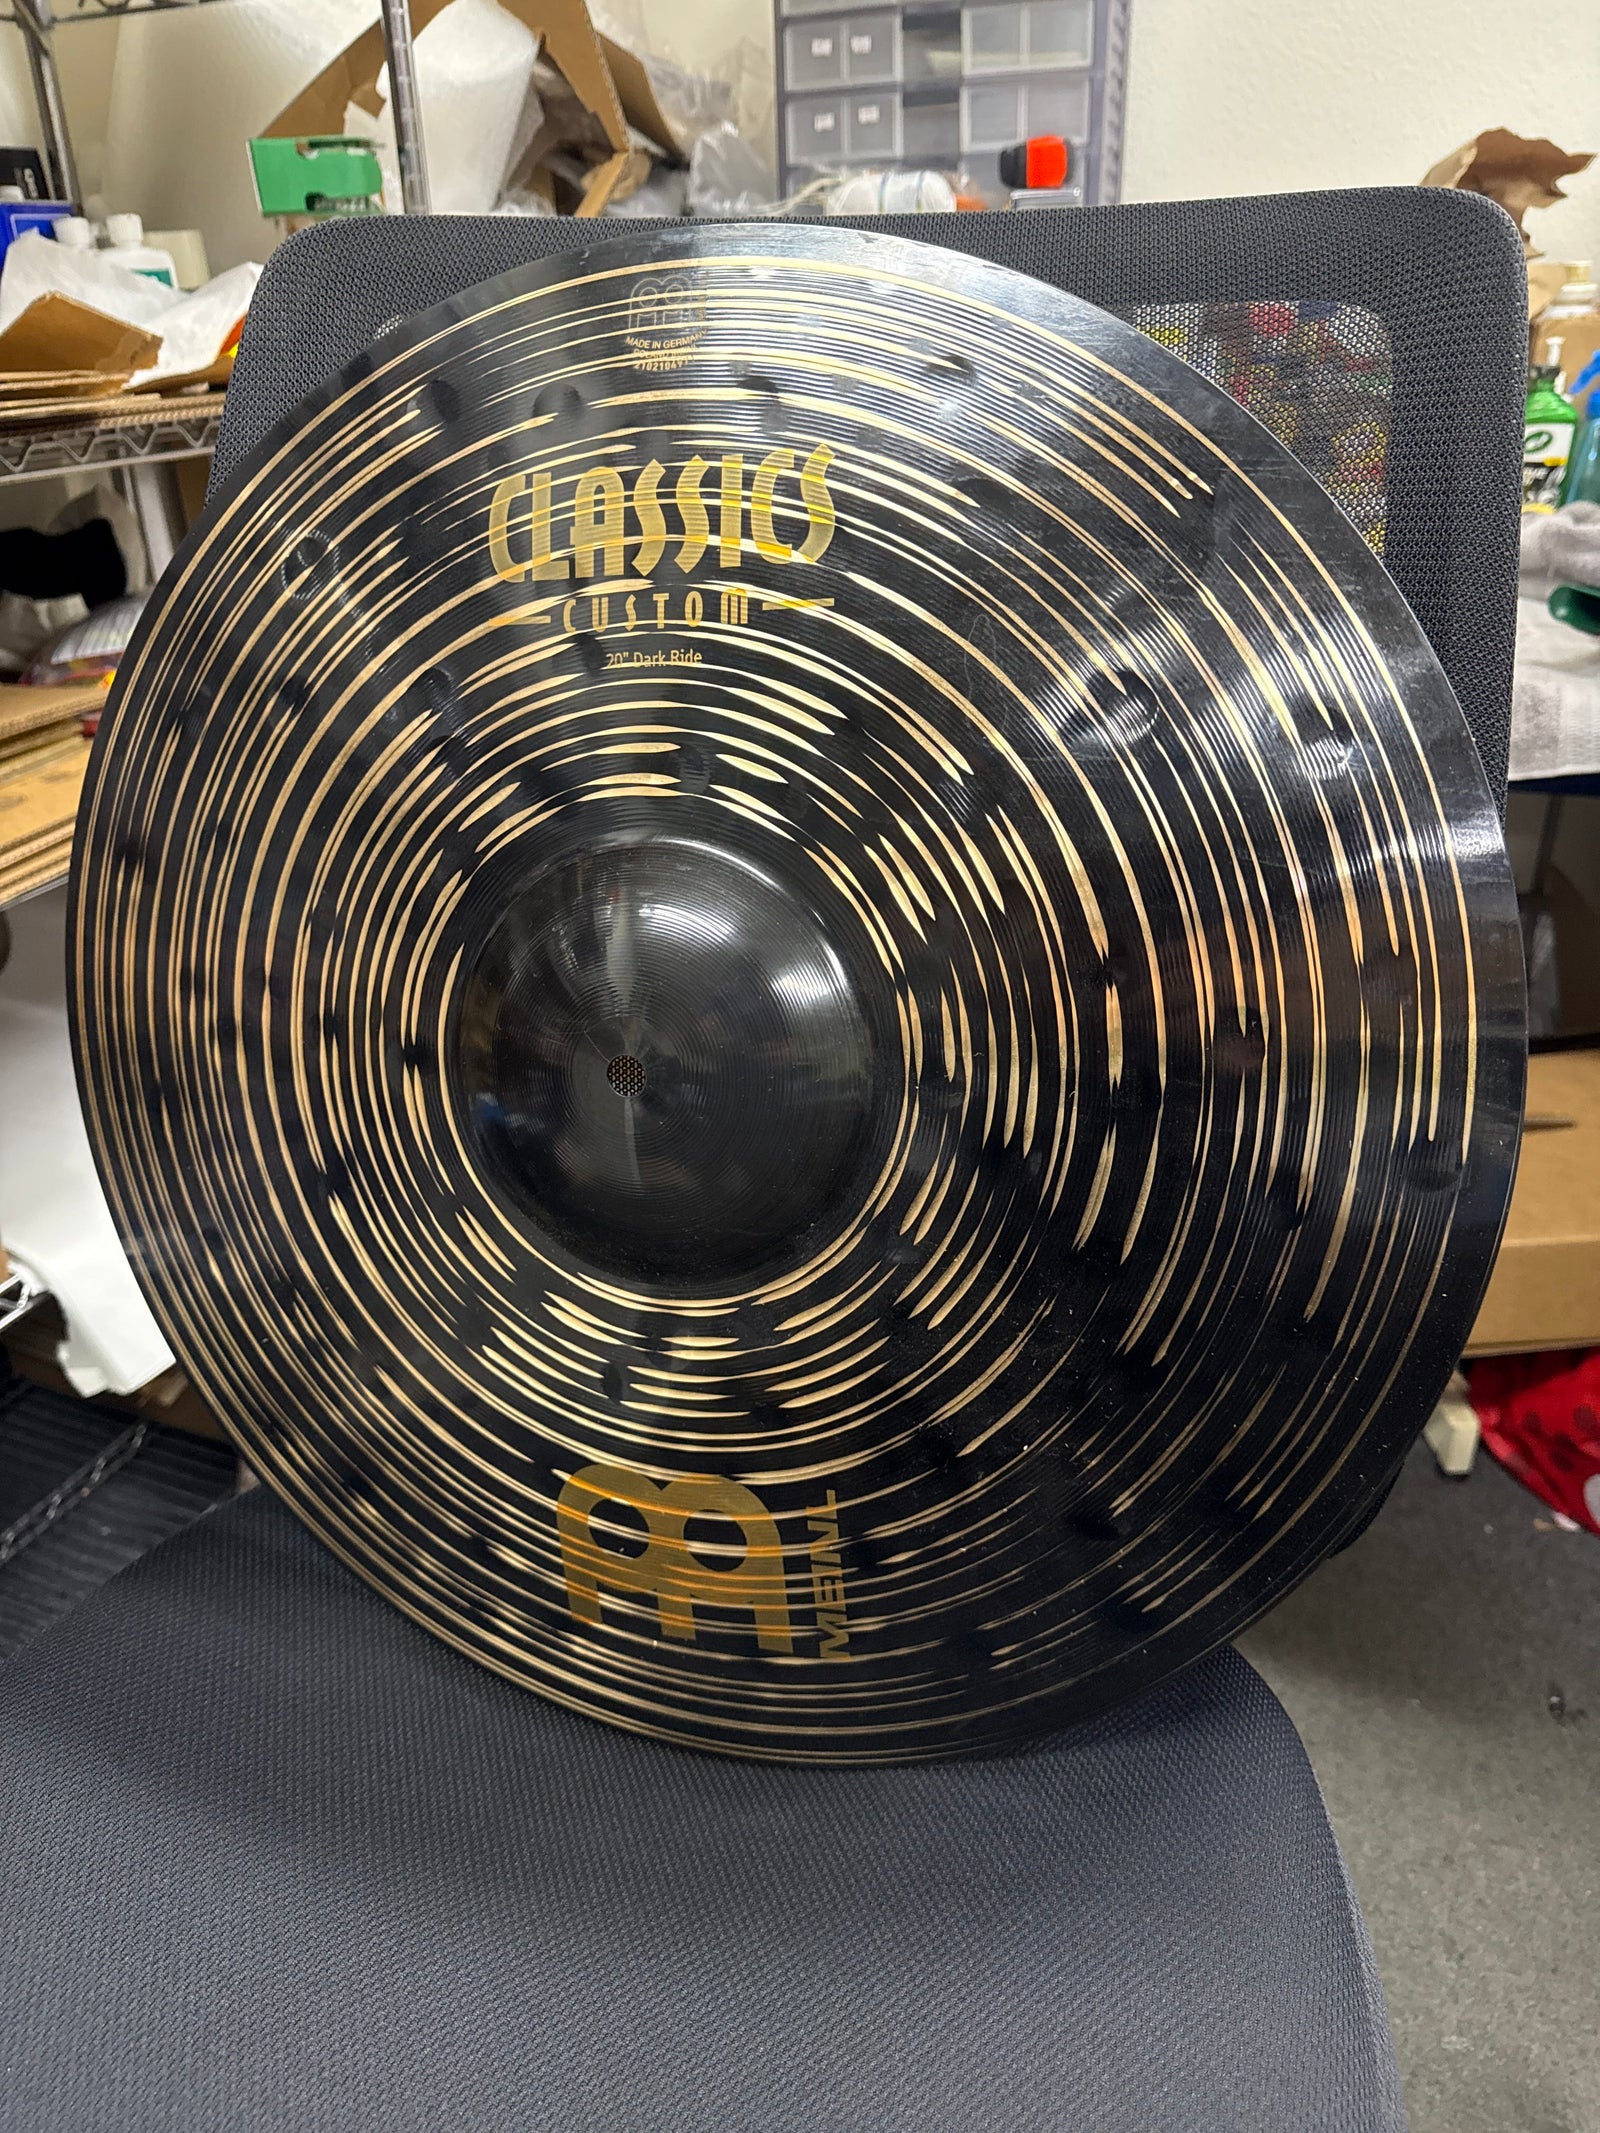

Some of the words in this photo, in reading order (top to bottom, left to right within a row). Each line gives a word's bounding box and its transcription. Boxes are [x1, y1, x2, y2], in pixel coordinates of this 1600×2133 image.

[625, 336, 651, 349] MADE
[651, 340, 662, 349] IN
[662, 328, 708, 349] GERMANY
[488, 443, 836, 583] CLASSICS
[563, 588, 749, 632] CUSTOM
[605, 651, 629, 669] 20"
[633, 649, 666, 667] Dark
[670, 648, 703, 666] Ride
[805, 1489, 851, 1661] MEINL
